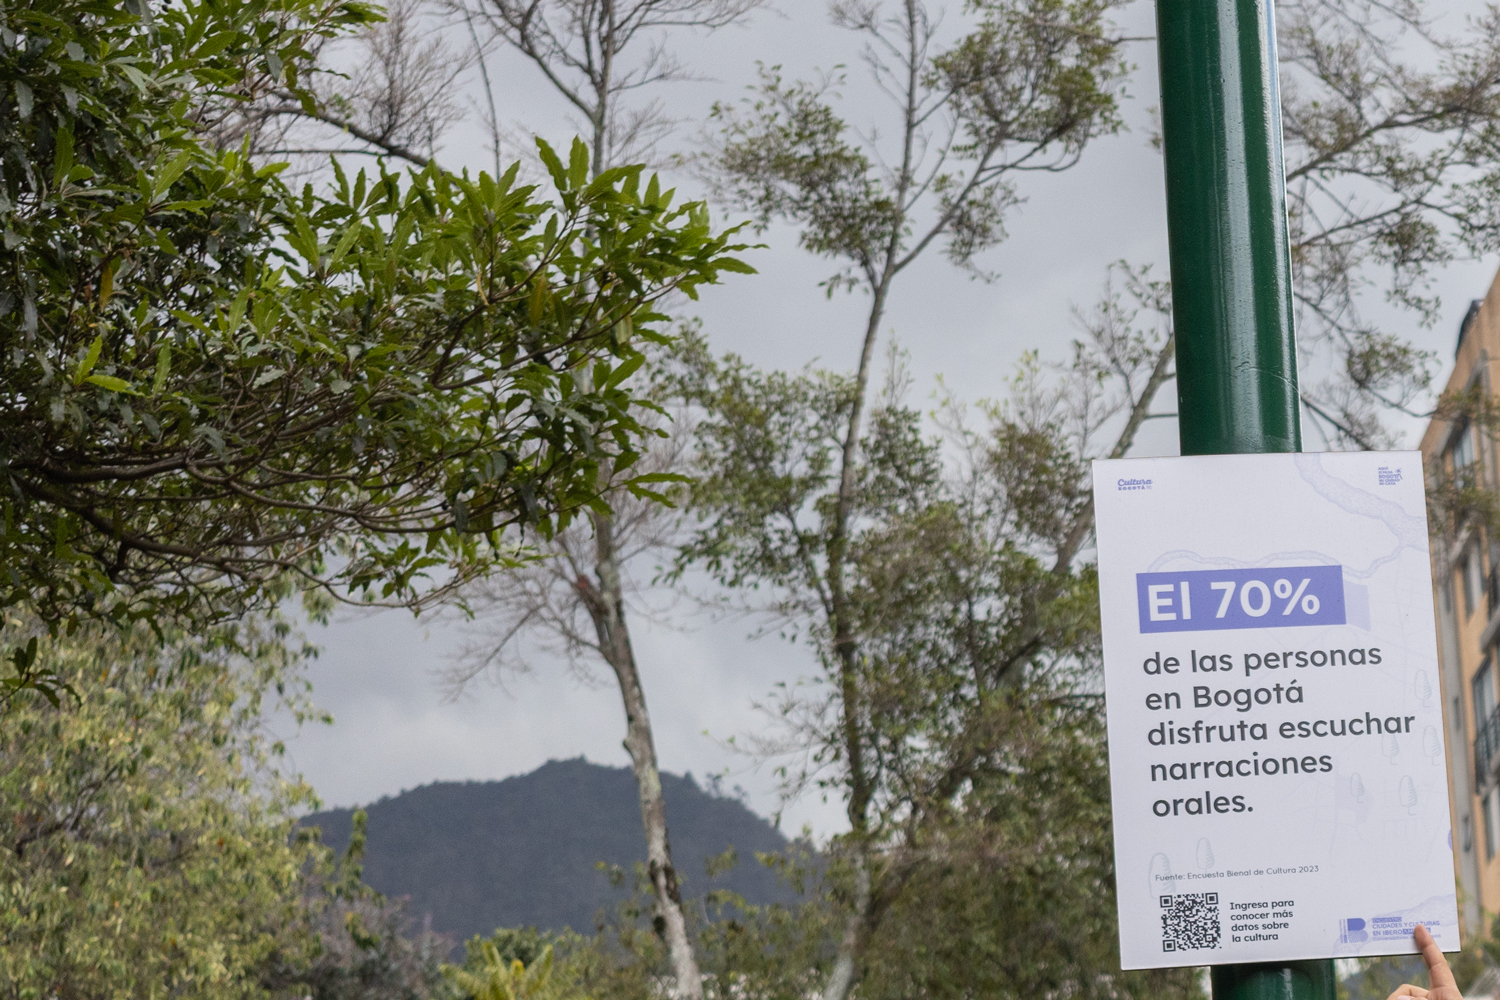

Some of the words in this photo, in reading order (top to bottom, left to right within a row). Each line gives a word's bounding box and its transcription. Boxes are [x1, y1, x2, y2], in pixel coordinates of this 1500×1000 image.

[1117, 478, 1153, 487] Cultura
[1148, 581, 1191, 621] El
[1210, 578, 1321, 618] 70%
[1143, 651, 1180, 675] de
[1191, 650, 1233, 673] las
[1243, 647, 1382, 677] personas
[1145, 692, 1182, 710] en
[1193, 679, 1304, 713] Bogotá
[1147, 719, 1268, 746] disfruta
[1278, 712, 1416, 739] escuchar
[1150, 751, 1333, 782] narraciones
[1152, 790, 1254, 817] orales.
[1155, 873, 1186, 881] Fuente:
[1187, 871, 1225, 880] Encuesta
[1226, 869, 1252, 877] Bienal
[1253, 868, 1264, 876] de
[1266, 866, 1297, 875] Cultura
[1298, 865, 1320, 873] 2023
[1229, 901, 1269, 912] Ingresa
[1271, 900, 1295, 911] para
[1230, 912, 1270, 921] conocer
[1272, 909, 1294, 919] más
[1231, 923, 1260, 932] datos
[1261, 921, 1290, 930] sobre
[1231, 934, 1242, 943] la
[1243, 932, 1279, 942] cultura
